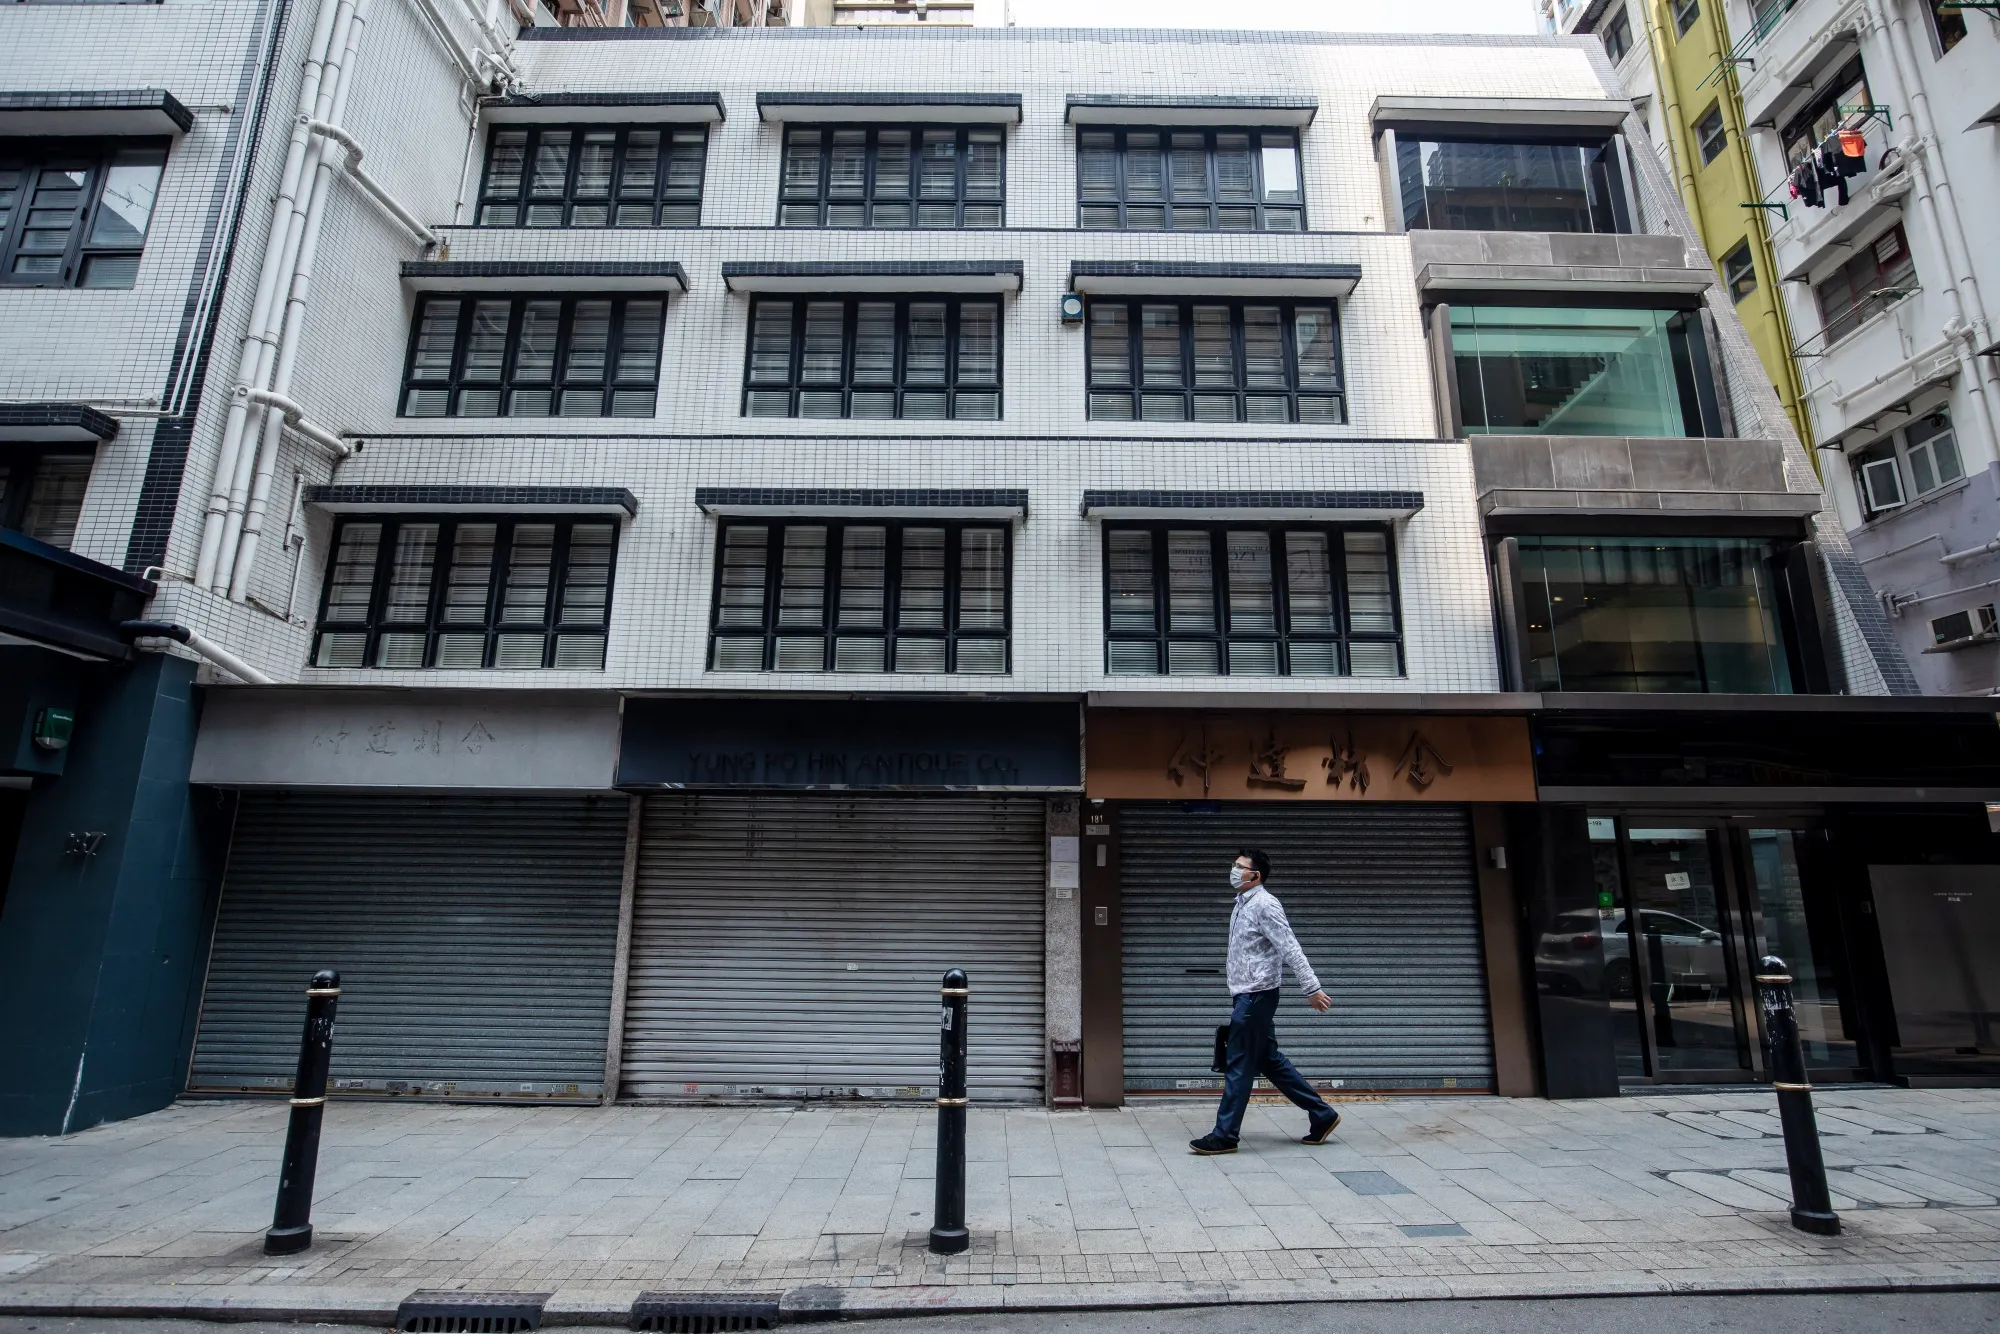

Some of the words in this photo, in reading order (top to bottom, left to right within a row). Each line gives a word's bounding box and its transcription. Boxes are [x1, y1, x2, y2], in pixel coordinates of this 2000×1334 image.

[688, 749, 756, 773] YUNG
[856, 750, 969, 772] ANTIQUE
[1090, 814, 1104, 824] 181
